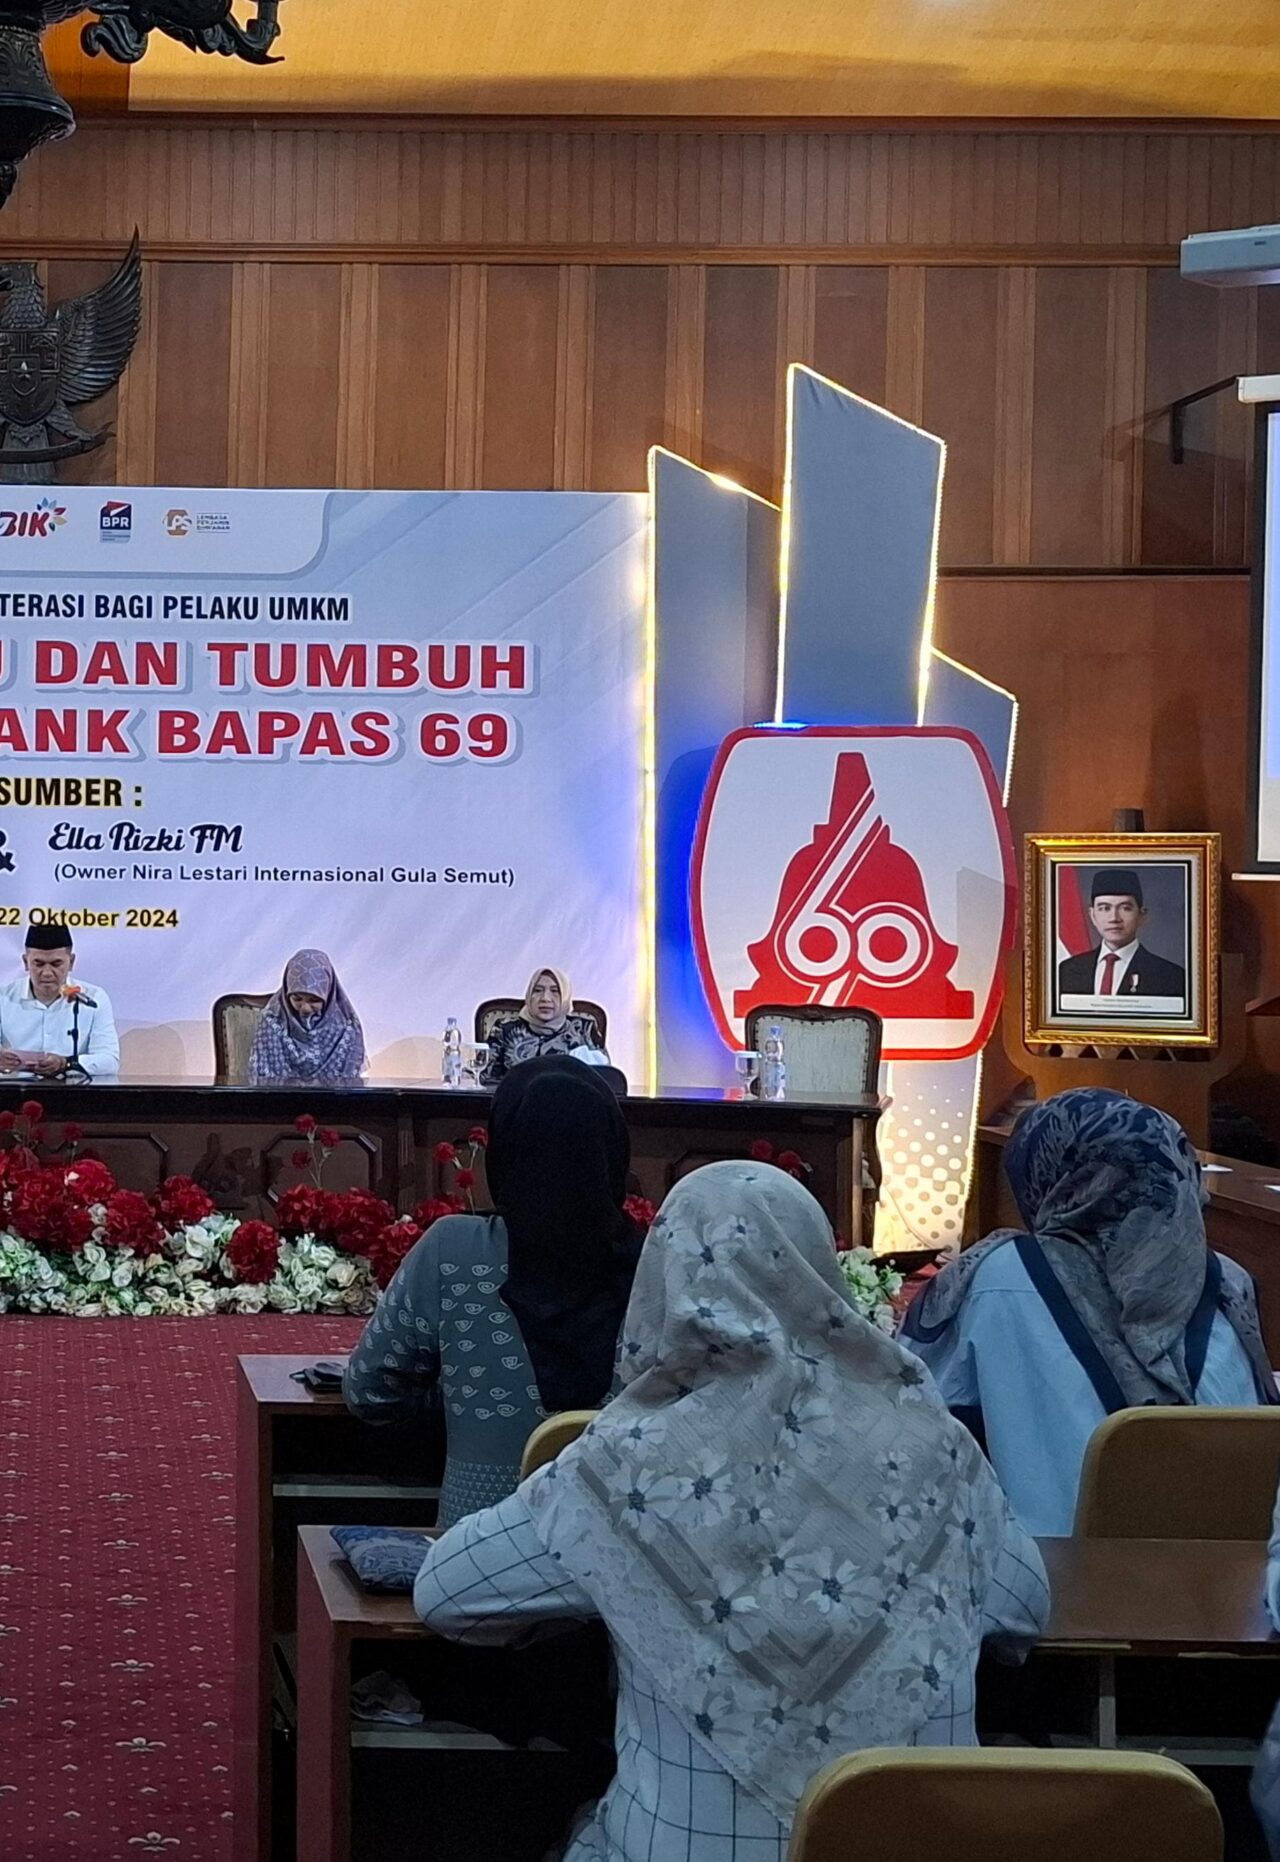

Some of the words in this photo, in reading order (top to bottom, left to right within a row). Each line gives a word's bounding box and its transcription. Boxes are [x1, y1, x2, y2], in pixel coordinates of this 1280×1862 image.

[102, 516, 129, 527] BPR
[95, 594, 152, 619] BAGI
[163, 596, 259, 620] PELAKU
[270, 597, 348, 621] UMKM
[35, 640, 178, 686] DAN
[207, 643, 525, 689] TUMBUH
[157, 710, 391, 755] BAPAS
[420, 712, 508, 757] 69
[48, 822, 104, 851] Ella
[109, 822, 185, 852] Rizki
[190, 824, 243, 853] FM
[54, 863, 126, 882] (Owner
[133, 865, 172, 880] Nira
[179, 865, 247, 881] Lestari
[254, 866, 384, 882] Internasional
[391, 867, 437, 883] Gula
[443, 868, 514, 887] Semut)
[28, 907, 120, 927] Oktober
[126, 909, 178, 927] 2024
